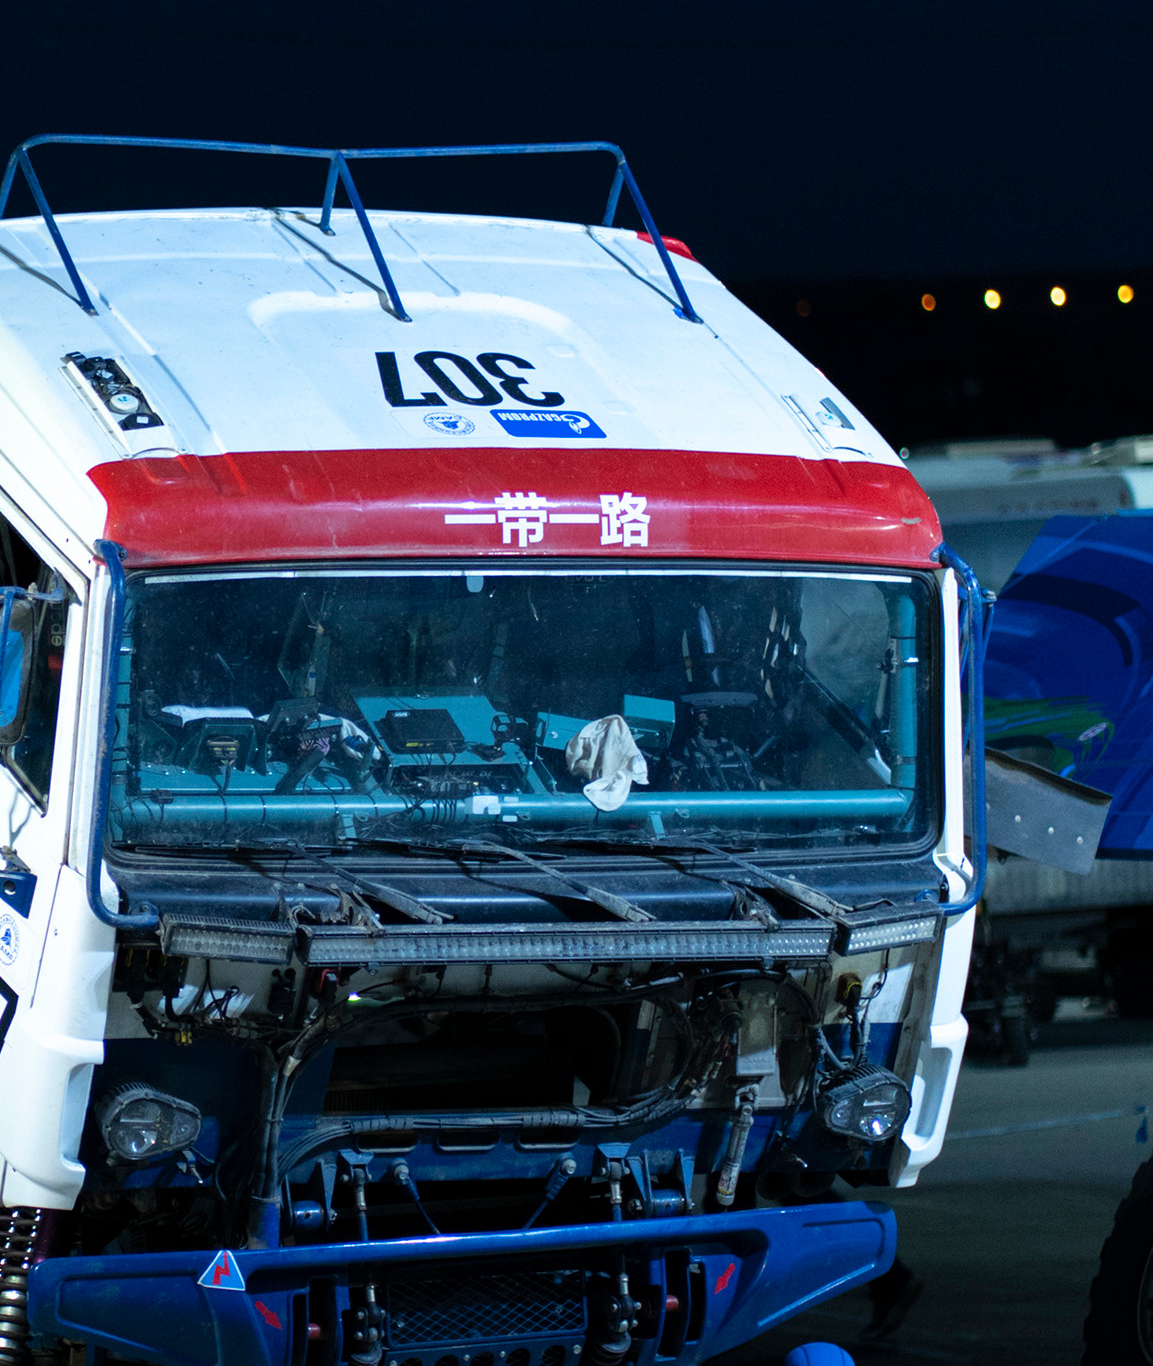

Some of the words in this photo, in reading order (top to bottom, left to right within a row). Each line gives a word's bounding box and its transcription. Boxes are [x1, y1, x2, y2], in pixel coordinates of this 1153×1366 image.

[375, 350, 566, 408] 307
[497, 411, 566, 422] GAZPROM
[444, 490, 651, 548] 一带一路
